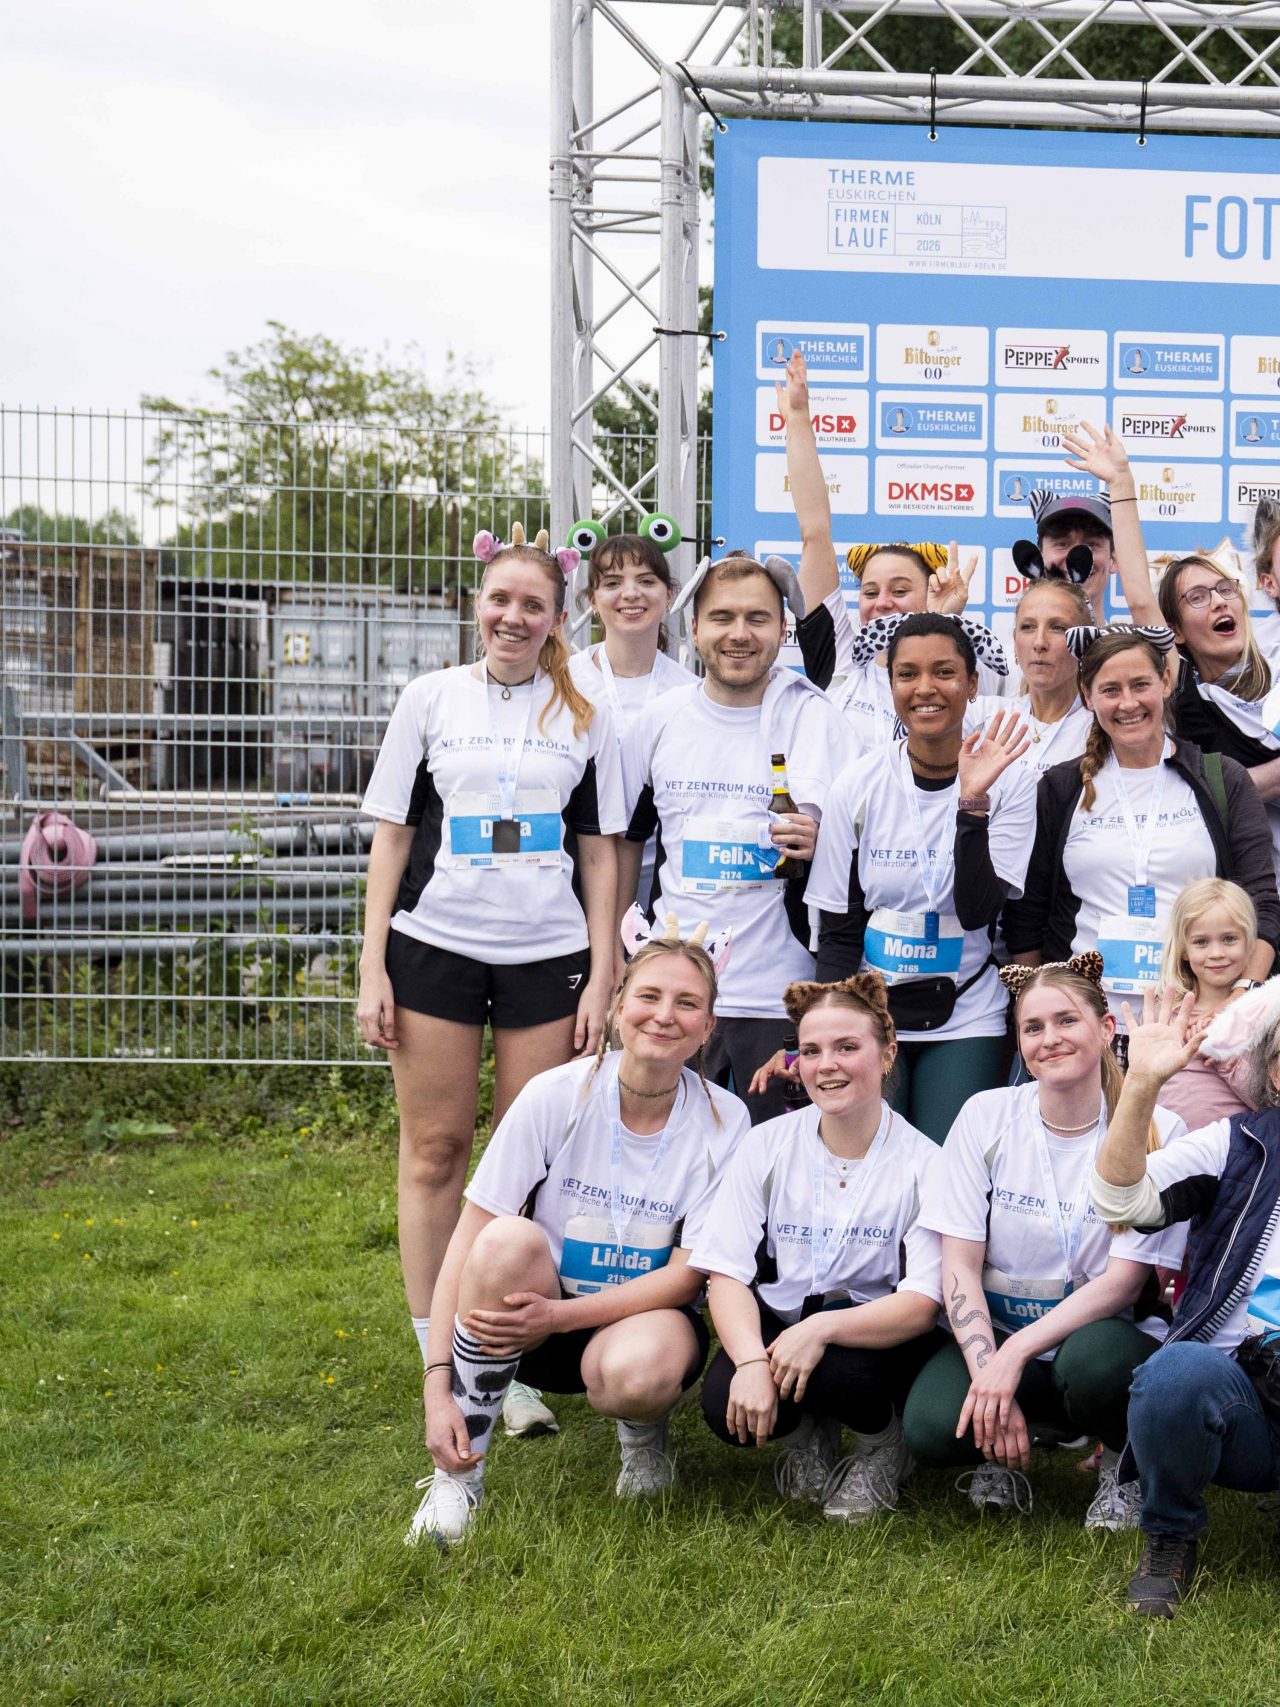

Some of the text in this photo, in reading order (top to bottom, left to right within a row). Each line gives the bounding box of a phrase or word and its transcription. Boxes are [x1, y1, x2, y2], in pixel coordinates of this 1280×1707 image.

[828, 168, 916, 187] THERME
[827, 188, 916, 202] EUSKIRCHEN
[835, 208, 890, 224] FIRMEN
[916, 211, 942, 226] KÖLN
[835, 227, 889, 249] LAUF
[916, 239, 941, 252] 2026
[798, 341, 857, 354] THERME
[802, 354, 858, 364] USKIRCHEN
[904, 347, 962, 368] Bitburger
[1066, 356, 1100, 364] SPORTS
[1155, 350, 1213, 364] THERME
[1154, 364, 1213, 374] EUSKIRCHEN
[918, 410, 976, 422] THERME
[917, 423, 976, 432] EUSKIRCHEN
[1022, 415, 1079, 434] Bitburger
[1182, 425, 1216, 433] SPORTS
[1036, 478, 1093, 490] THERME
[888, 482, 954, 502] DKMS
[1139, 484, 1196, 504] Bitburger
[442, 736, 570, 752] VET ZENRM KÖLN
[666, 780, 772, 796] VET ZENTRUM KÖL
[708, 844, 755, 866] Felix
[870, 849, 892, 858] VET
[720, 870, 742, 880] 2174
[884, 937, 938, 959] Mona
[898, 964, 919, 973] 2165
[562, 1178, 582, 1190] VET
[650, 1200, 675, 1214] KÖL
[995, 1186, 1015, 1202] VET
[644, 1211, 669, 1222] Kleint
[776, 1224, 798, 1234] VET
[591, 1246, 652, 1270] Linda
